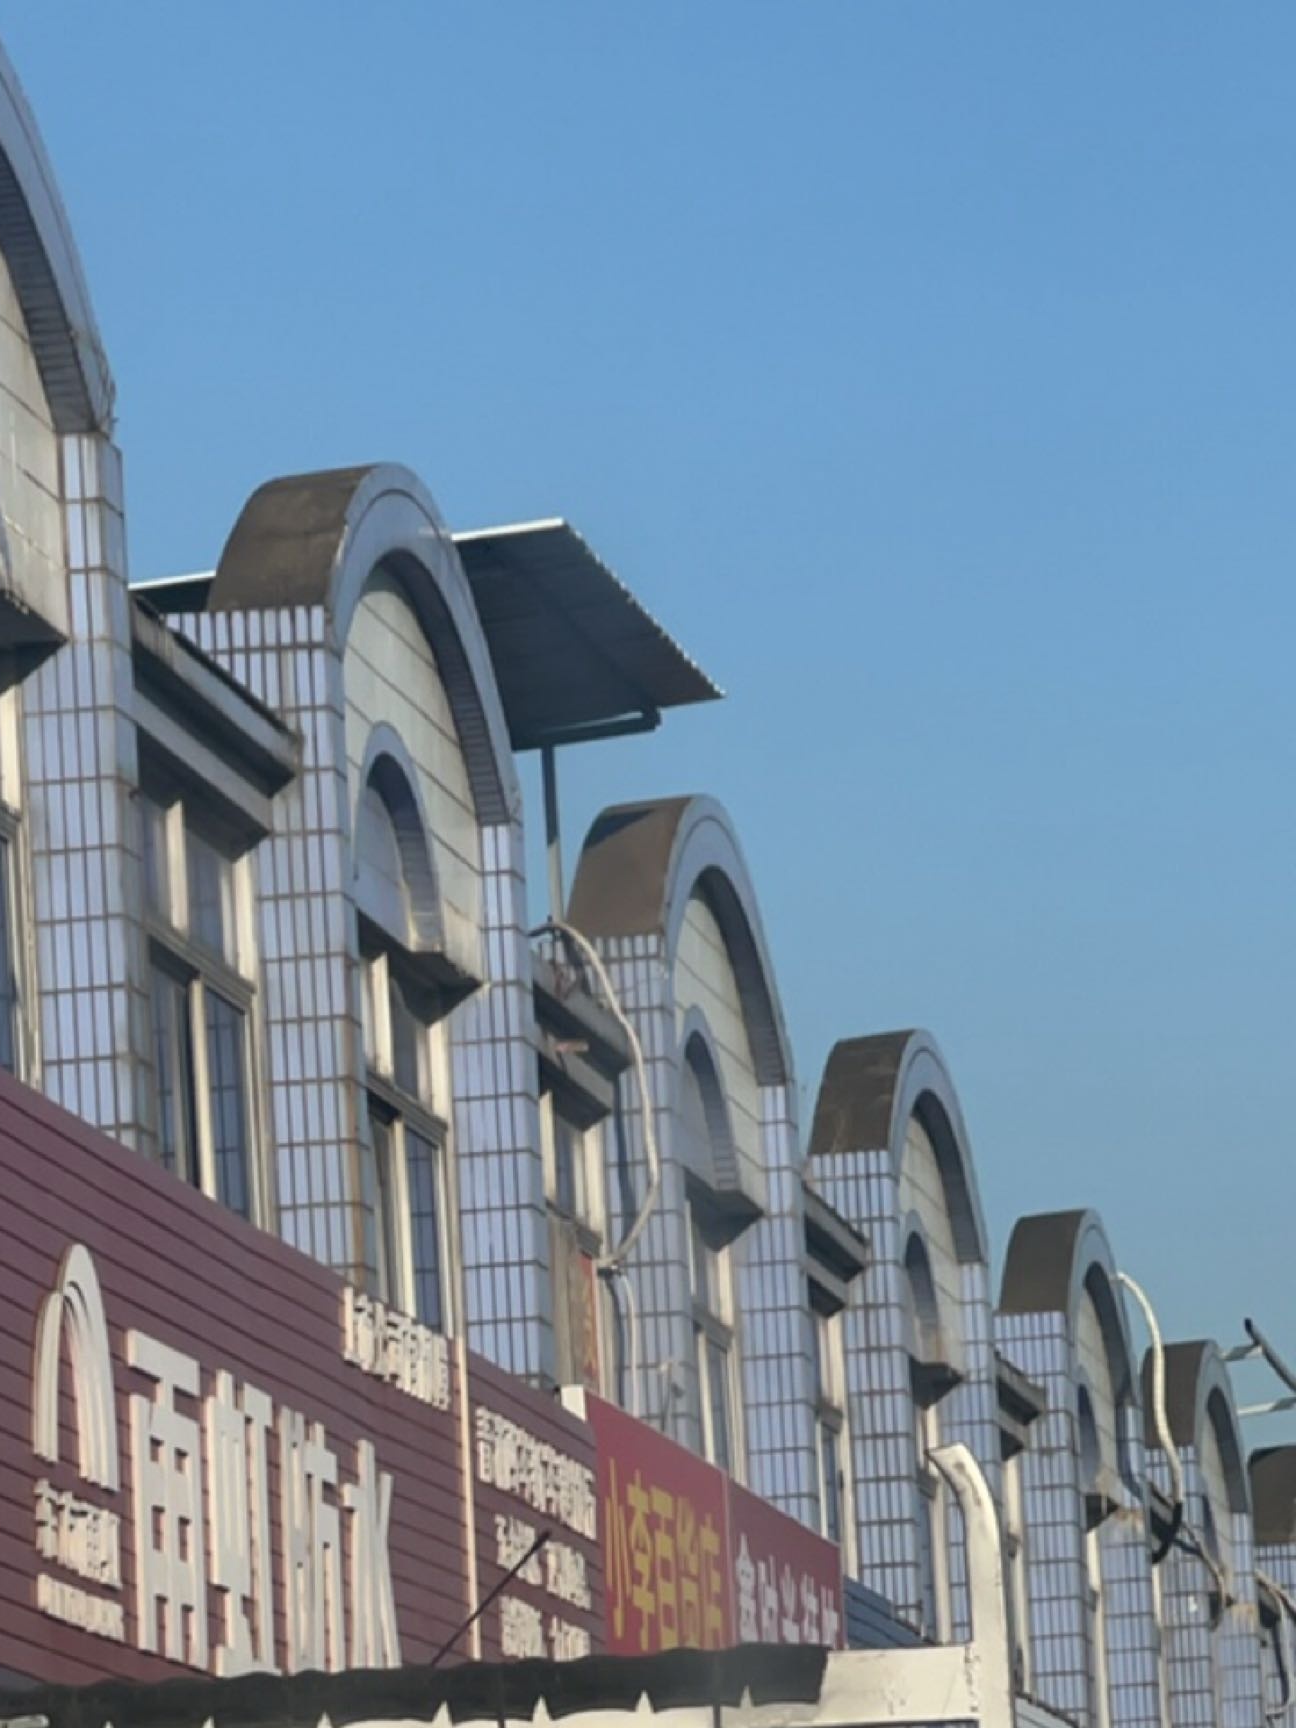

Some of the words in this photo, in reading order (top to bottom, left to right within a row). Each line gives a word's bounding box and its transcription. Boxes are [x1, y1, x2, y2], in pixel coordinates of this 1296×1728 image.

[126, 1329, 402, 1678] 雨虹防水
[604, 1457, 724, 1653] 小李百货店
